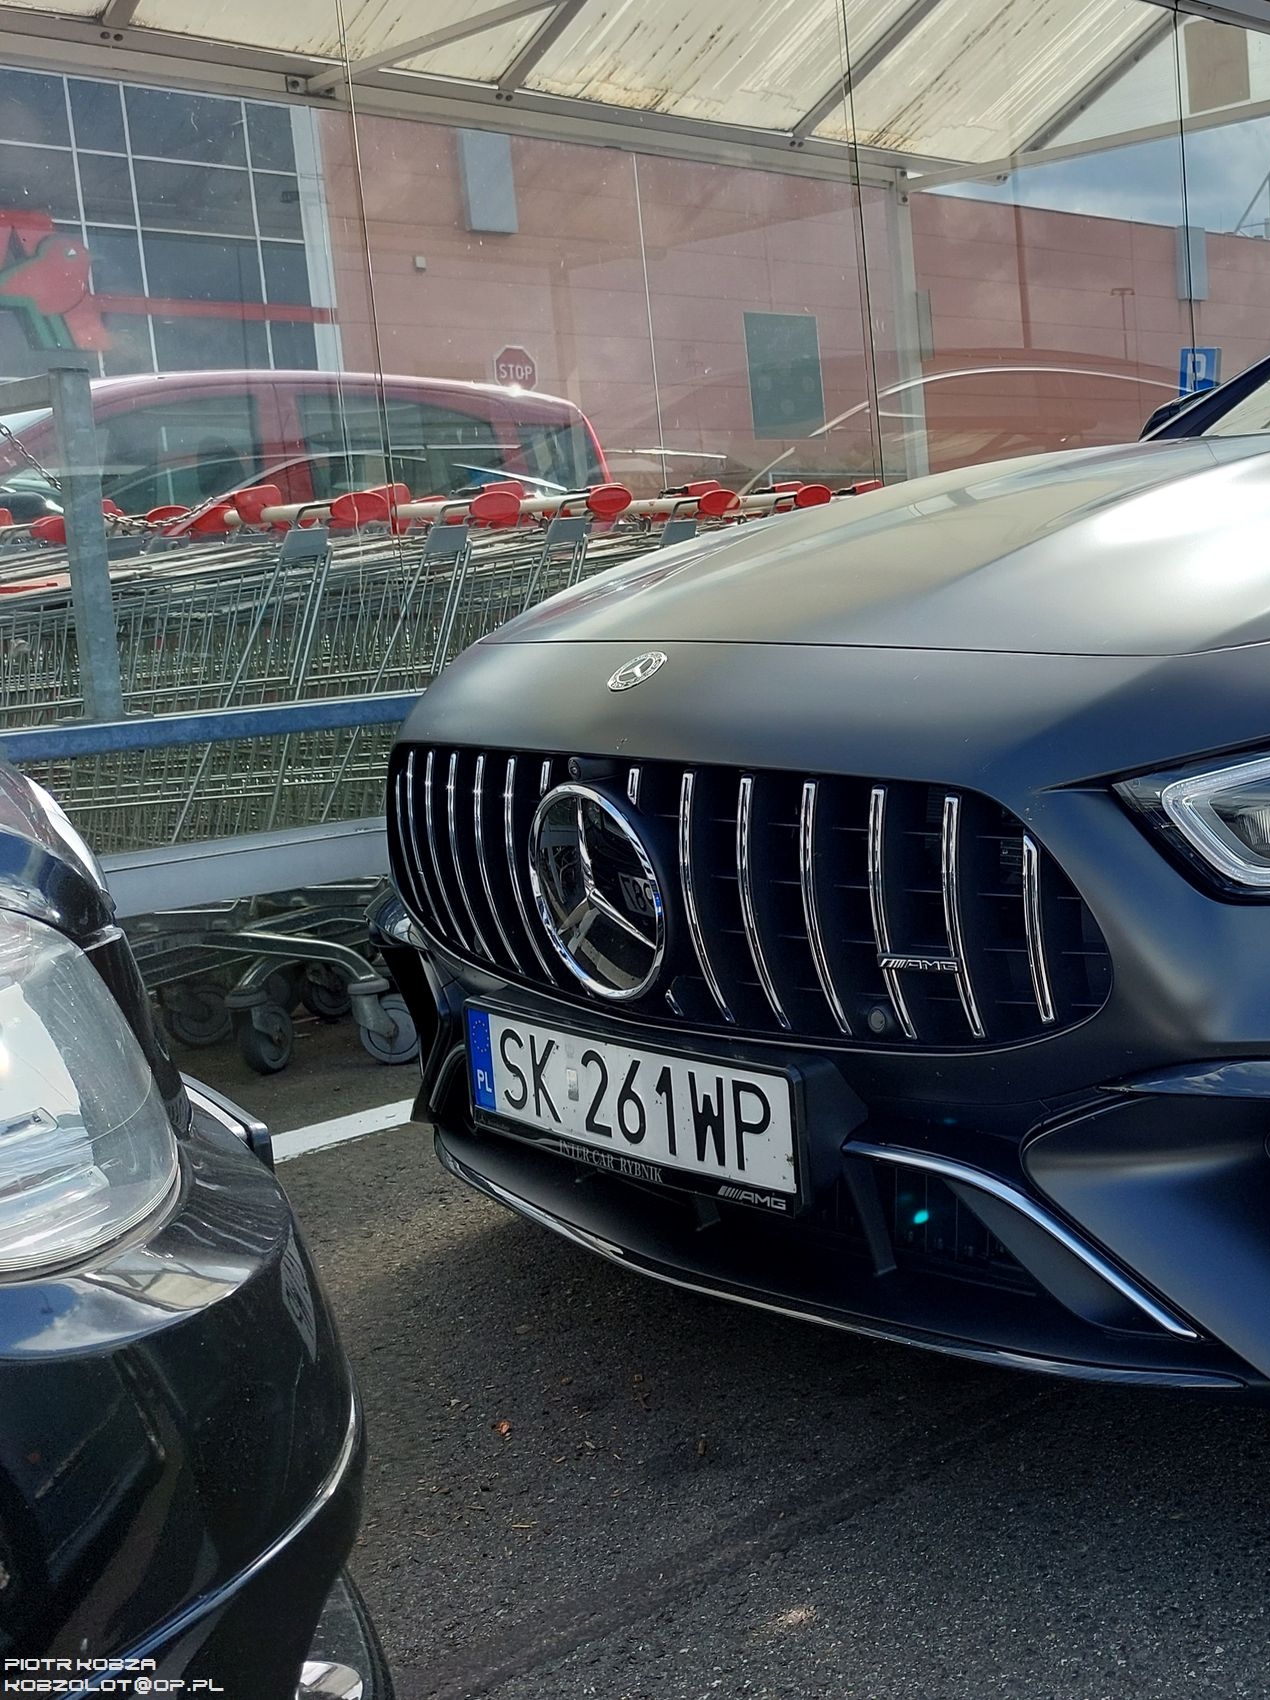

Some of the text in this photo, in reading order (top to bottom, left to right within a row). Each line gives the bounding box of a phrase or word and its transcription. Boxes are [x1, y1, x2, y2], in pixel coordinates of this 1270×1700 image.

[499, 363, 533, 380] STOP
[1186, 353, 1206, 392] P
[477, 1068, 493, 1093] PL
[500, 1028, 772, 1171] SK 261WP
[559, 1140, 664, 1184] INTER-CAR RYBNIK
